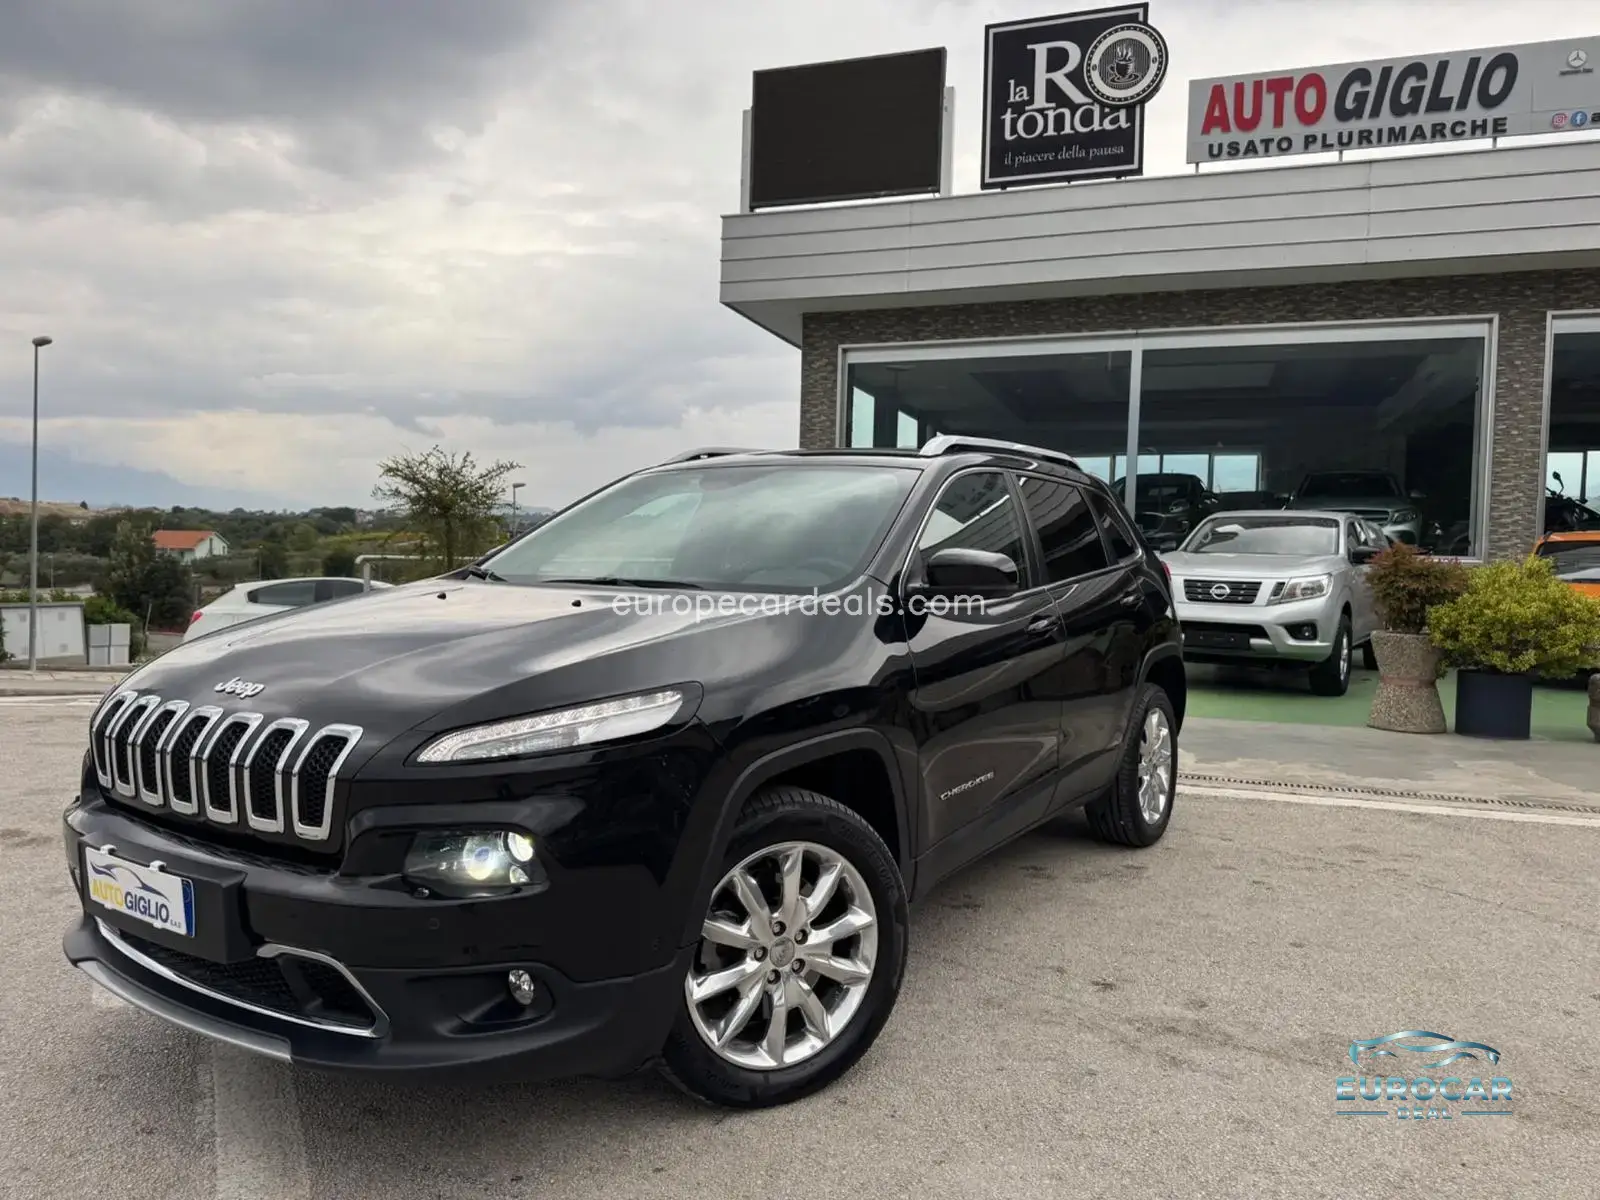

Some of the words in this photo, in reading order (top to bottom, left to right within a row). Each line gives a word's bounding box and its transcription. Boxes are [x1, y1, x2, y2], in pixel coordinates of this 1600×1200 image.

[1007, 79, 1030, 103] la
[1201, 72, 1327, 136] AUTO
[1334, 52, 1519, 123] GIGLIO
[1000, 102, 1132, 141] tonda
[1207, 136, 1293, 158] USATO
[1303, 116, 1509, 151] PLURIMARCHE
[1004, 151, 1012, 166] il
[1014, 150, 1055, 168] piacere
[1057, 145, 1086, 161] della
[1089, 145, 1125, 161] pausa
[214, 676, 265, 699] Jeep
[940, 771, 995, 801] CHEROKEE
[91, 878, 124, 908] AUTO
[124, 891, 170, 923] GIGLIO
